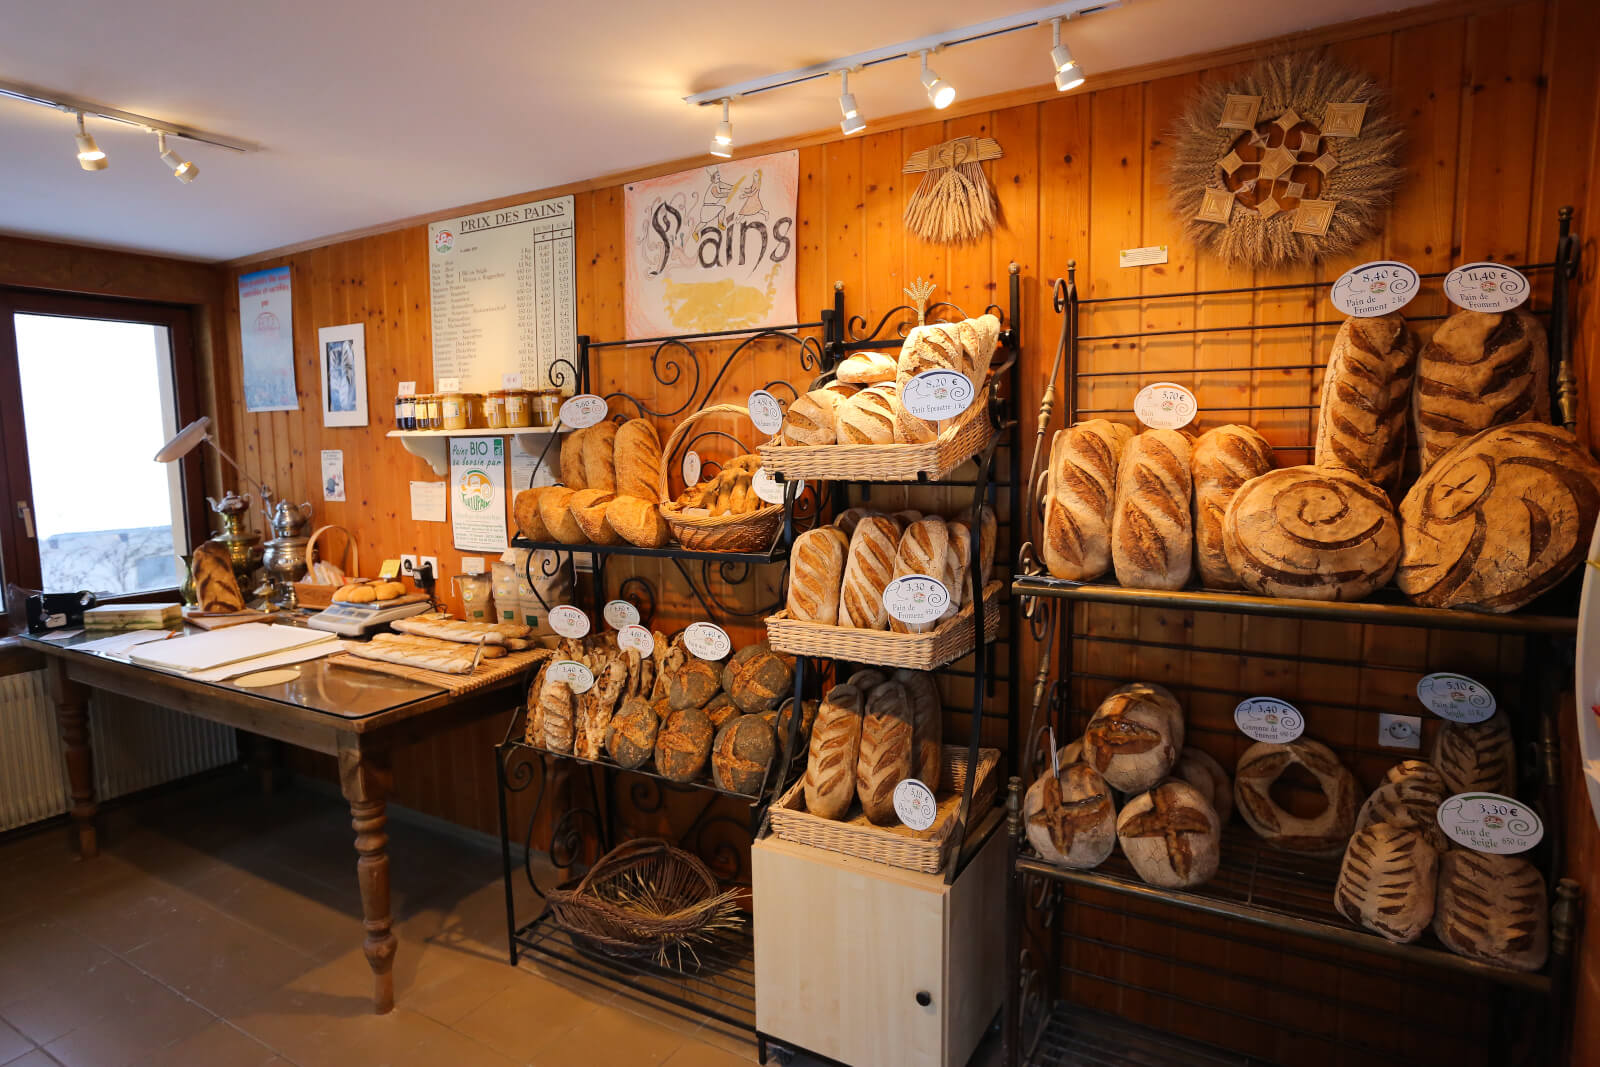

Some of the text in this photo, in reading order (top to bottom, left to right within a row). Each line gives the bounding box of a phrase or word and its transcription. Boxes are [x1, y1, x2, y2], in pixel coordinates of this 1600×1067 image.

[460, 201, 564, 232] PRIX DES PAINS
[650, 200, 793, 278] Pains
[1362, 269, 1400, 282] 8,40 €
[1468, 271, 1496, 281] 11,40
[1346, 295, 1376, 307] Pain de
[1354, 303, 1387, 315] Froment
[470, 441, 488, 455] BIO
[906, 582, 925, 592] 3,30
[1480, 802, 1518, 816] 3,30 €
[1455, 826, 1490, 837] Pain de
